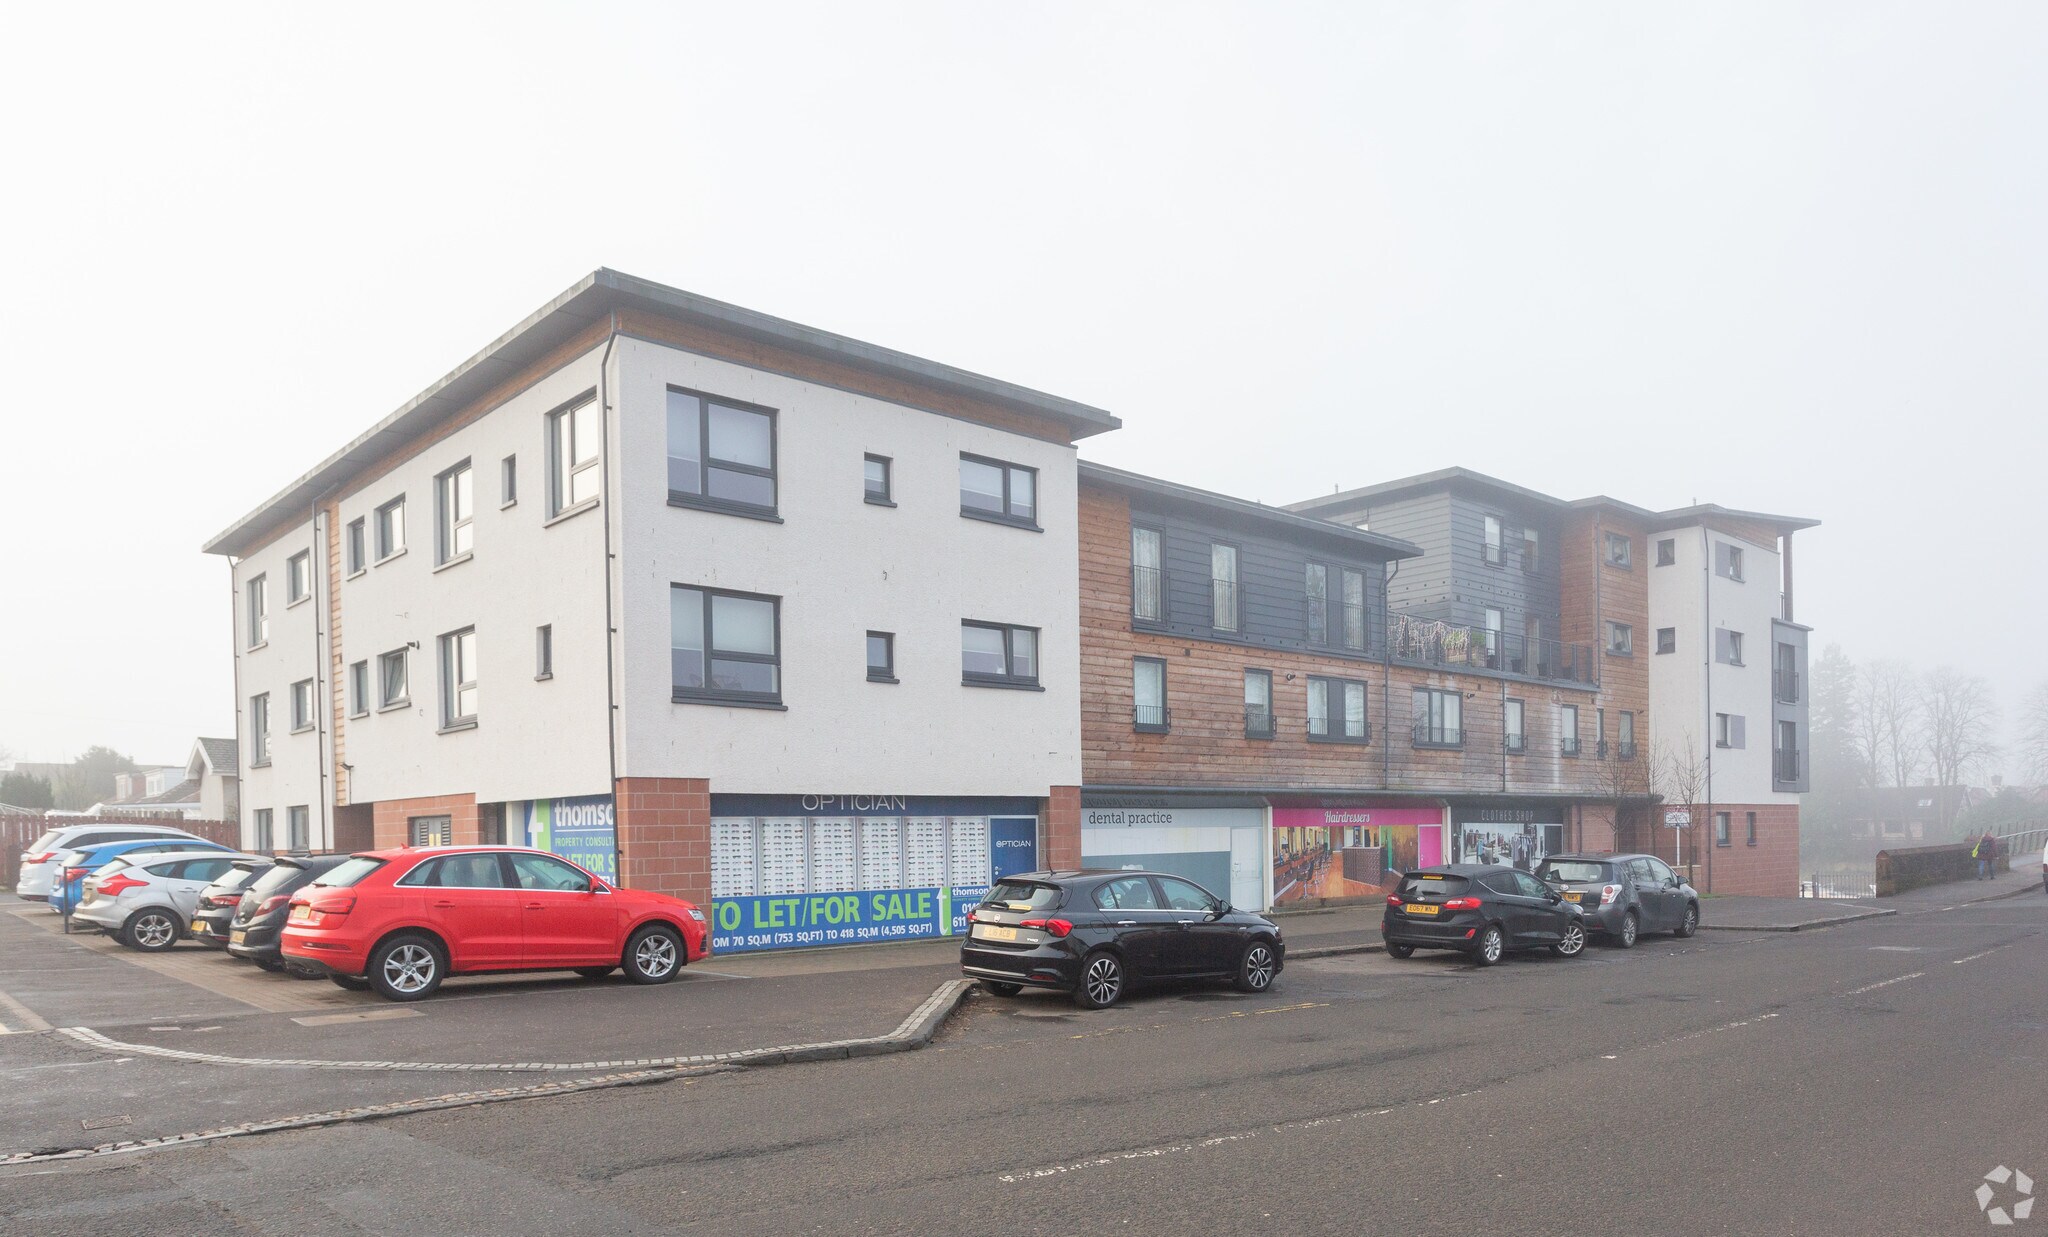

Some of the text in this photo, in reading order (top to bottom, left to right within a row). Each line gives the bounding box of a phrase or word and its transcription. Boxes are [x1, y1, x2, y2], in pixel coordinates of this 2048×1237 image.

[802, 794, 906, 811] OPTICIAN
[1088, 811, 1172, 827] dental practice
[1324, 810, 1370, 824] Hairdressers
[1481, 809, 1534, 821] CLOTHES SHOP
[555, 837, 583, 847] PROPERTY
[995, 839, 1032, 848] OPTICIAN
[952, 887, 989, 896] thomson
[753, 896, 860, 928] LET/FOR
[872, 892, 932, 921] SALE
[952, 916, 967, 928] 611
[732, 936, 744, 946] 70
[747, 934, 771, 946] SQ.M
[774, 932, 794, 945] (753
[796, 929, 823, 943] SQ.FT)
[826, 930, 838, 940] TO
[840, 928, 855, 939] 418
[857, 926, 879, 939] SQ.M
[881, 925, 906, 937] (4,505
[908, 922, 933, 935] SQ.FT)
